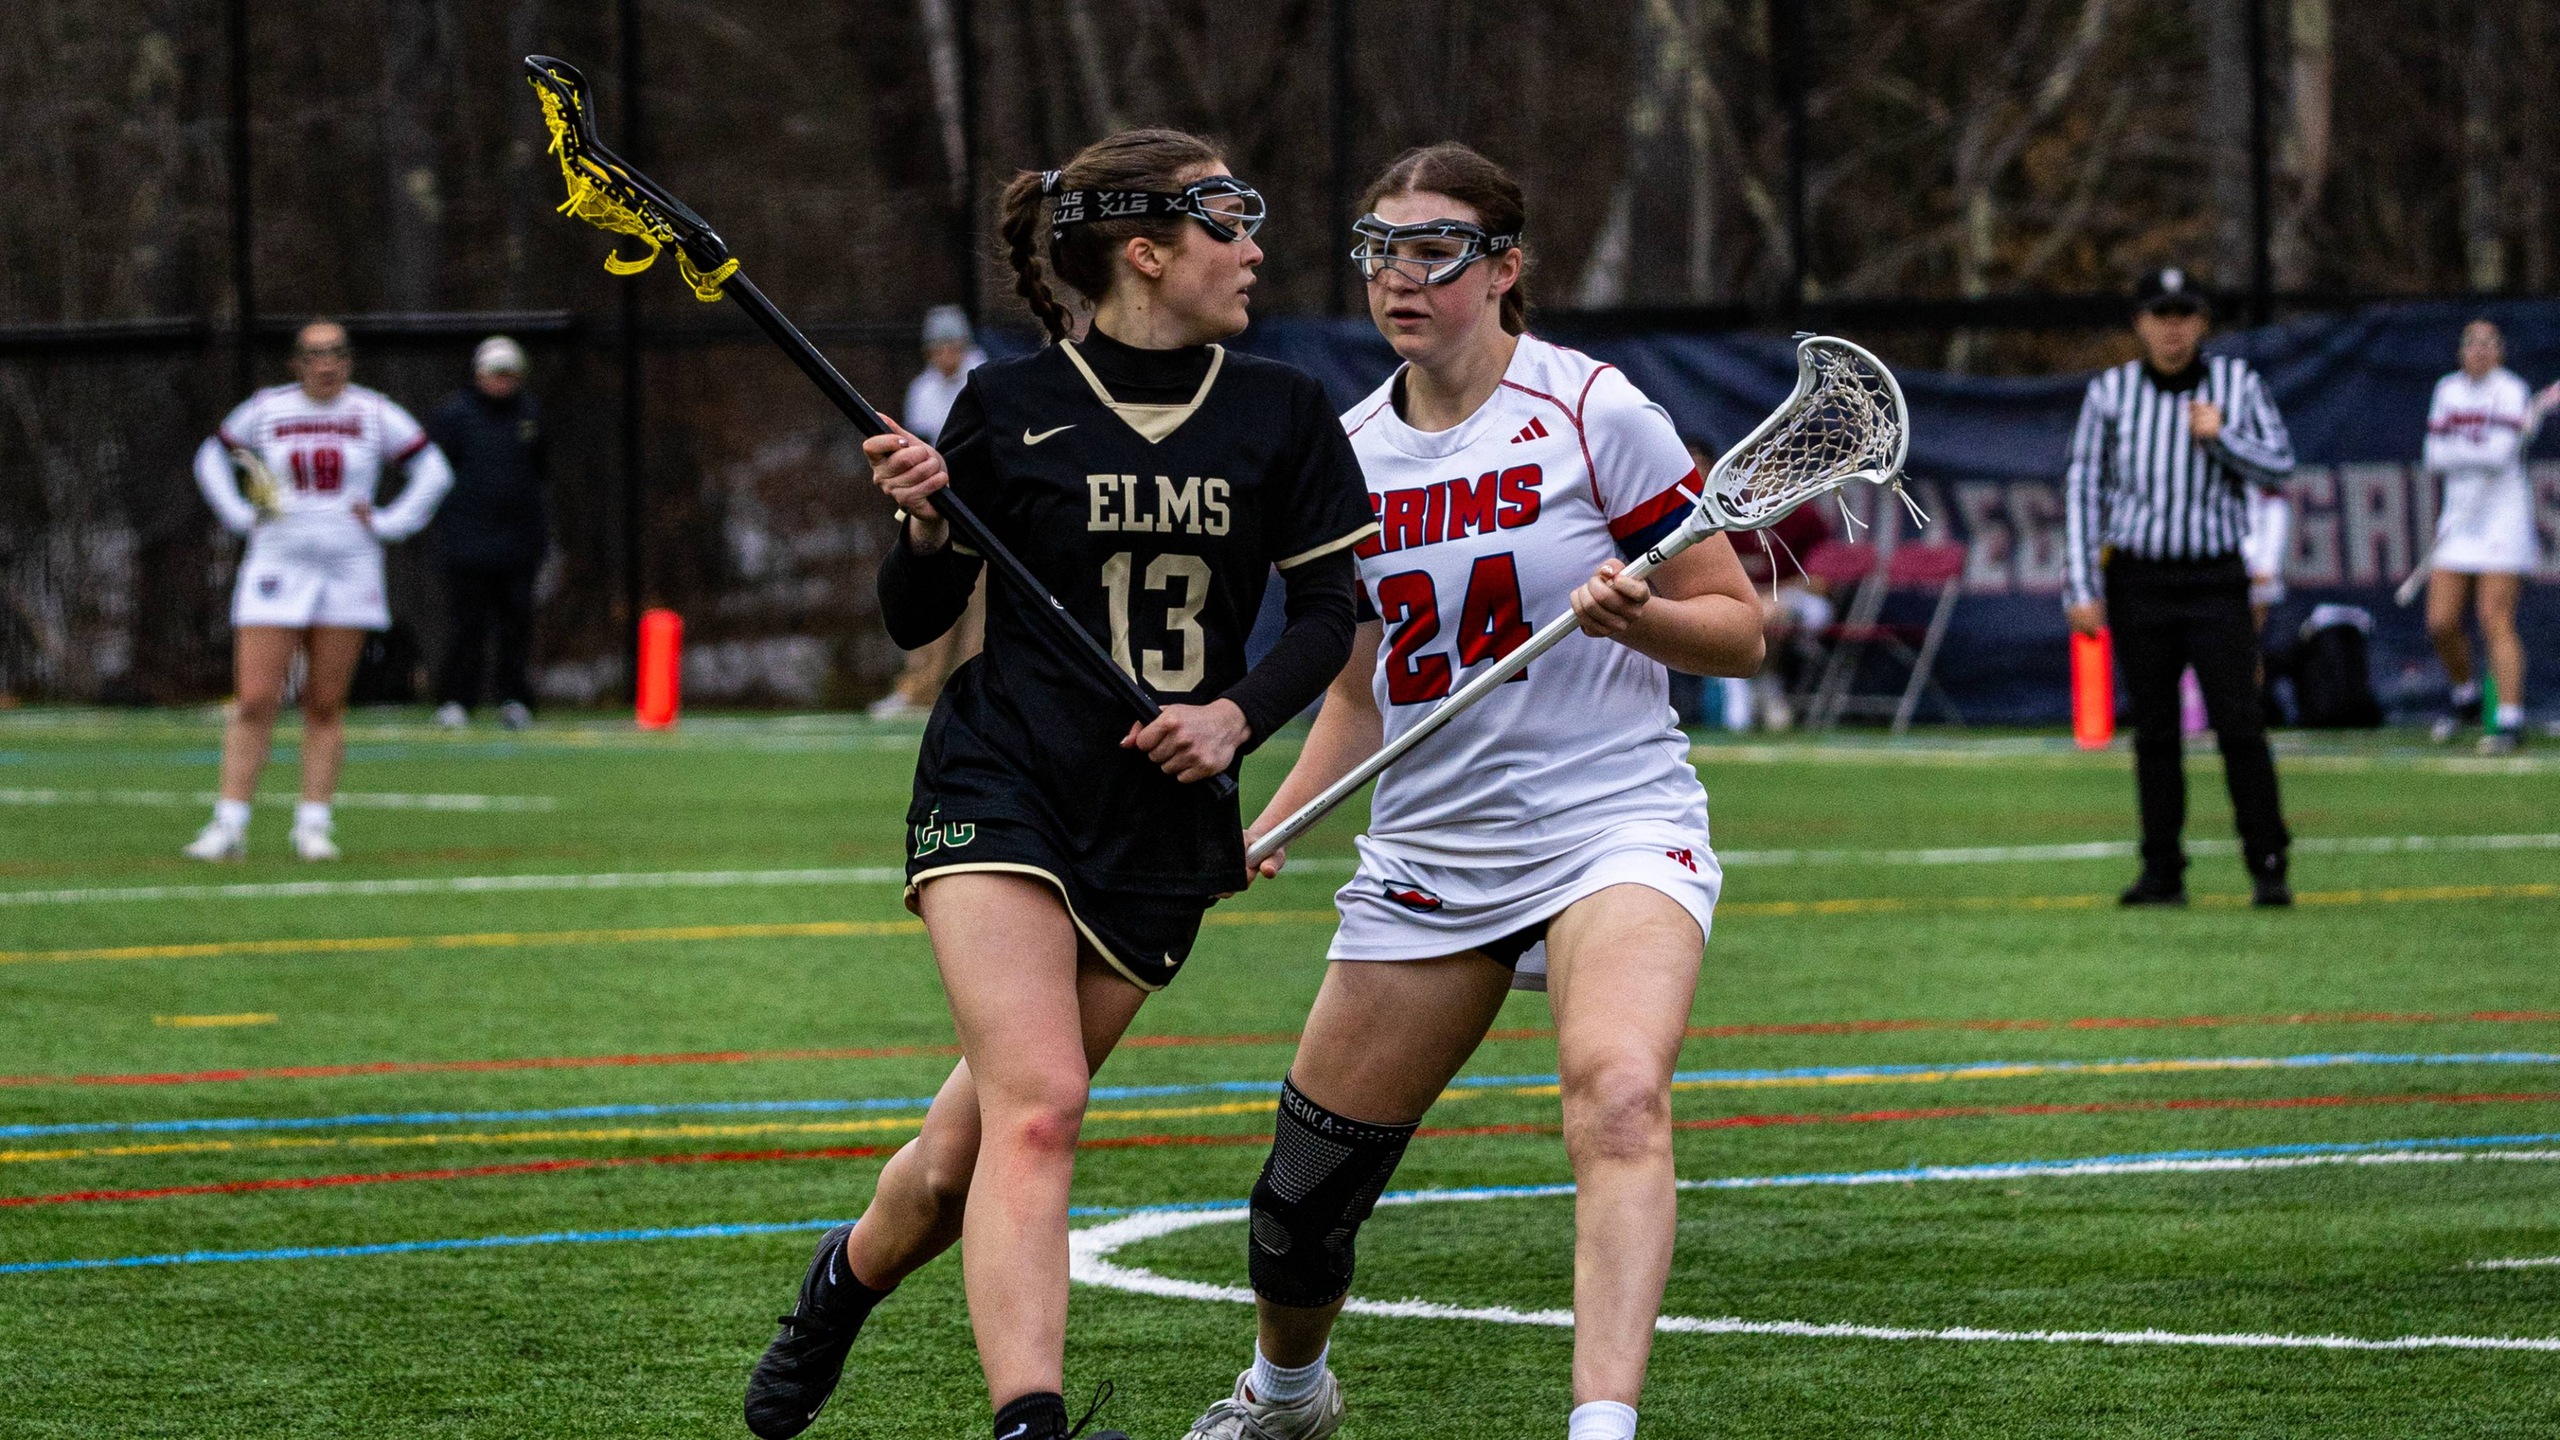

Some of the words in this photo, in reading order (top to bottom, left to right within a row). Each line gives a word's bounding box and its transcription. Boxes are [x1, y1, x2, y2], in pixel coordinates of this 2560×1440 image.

[1491, 234, 1514, 251] STX
[1086, 474, 1230, 536] ELMS
[1102, 551, 1212, 692] 13
[1377, 551, 1534, 706] 24
